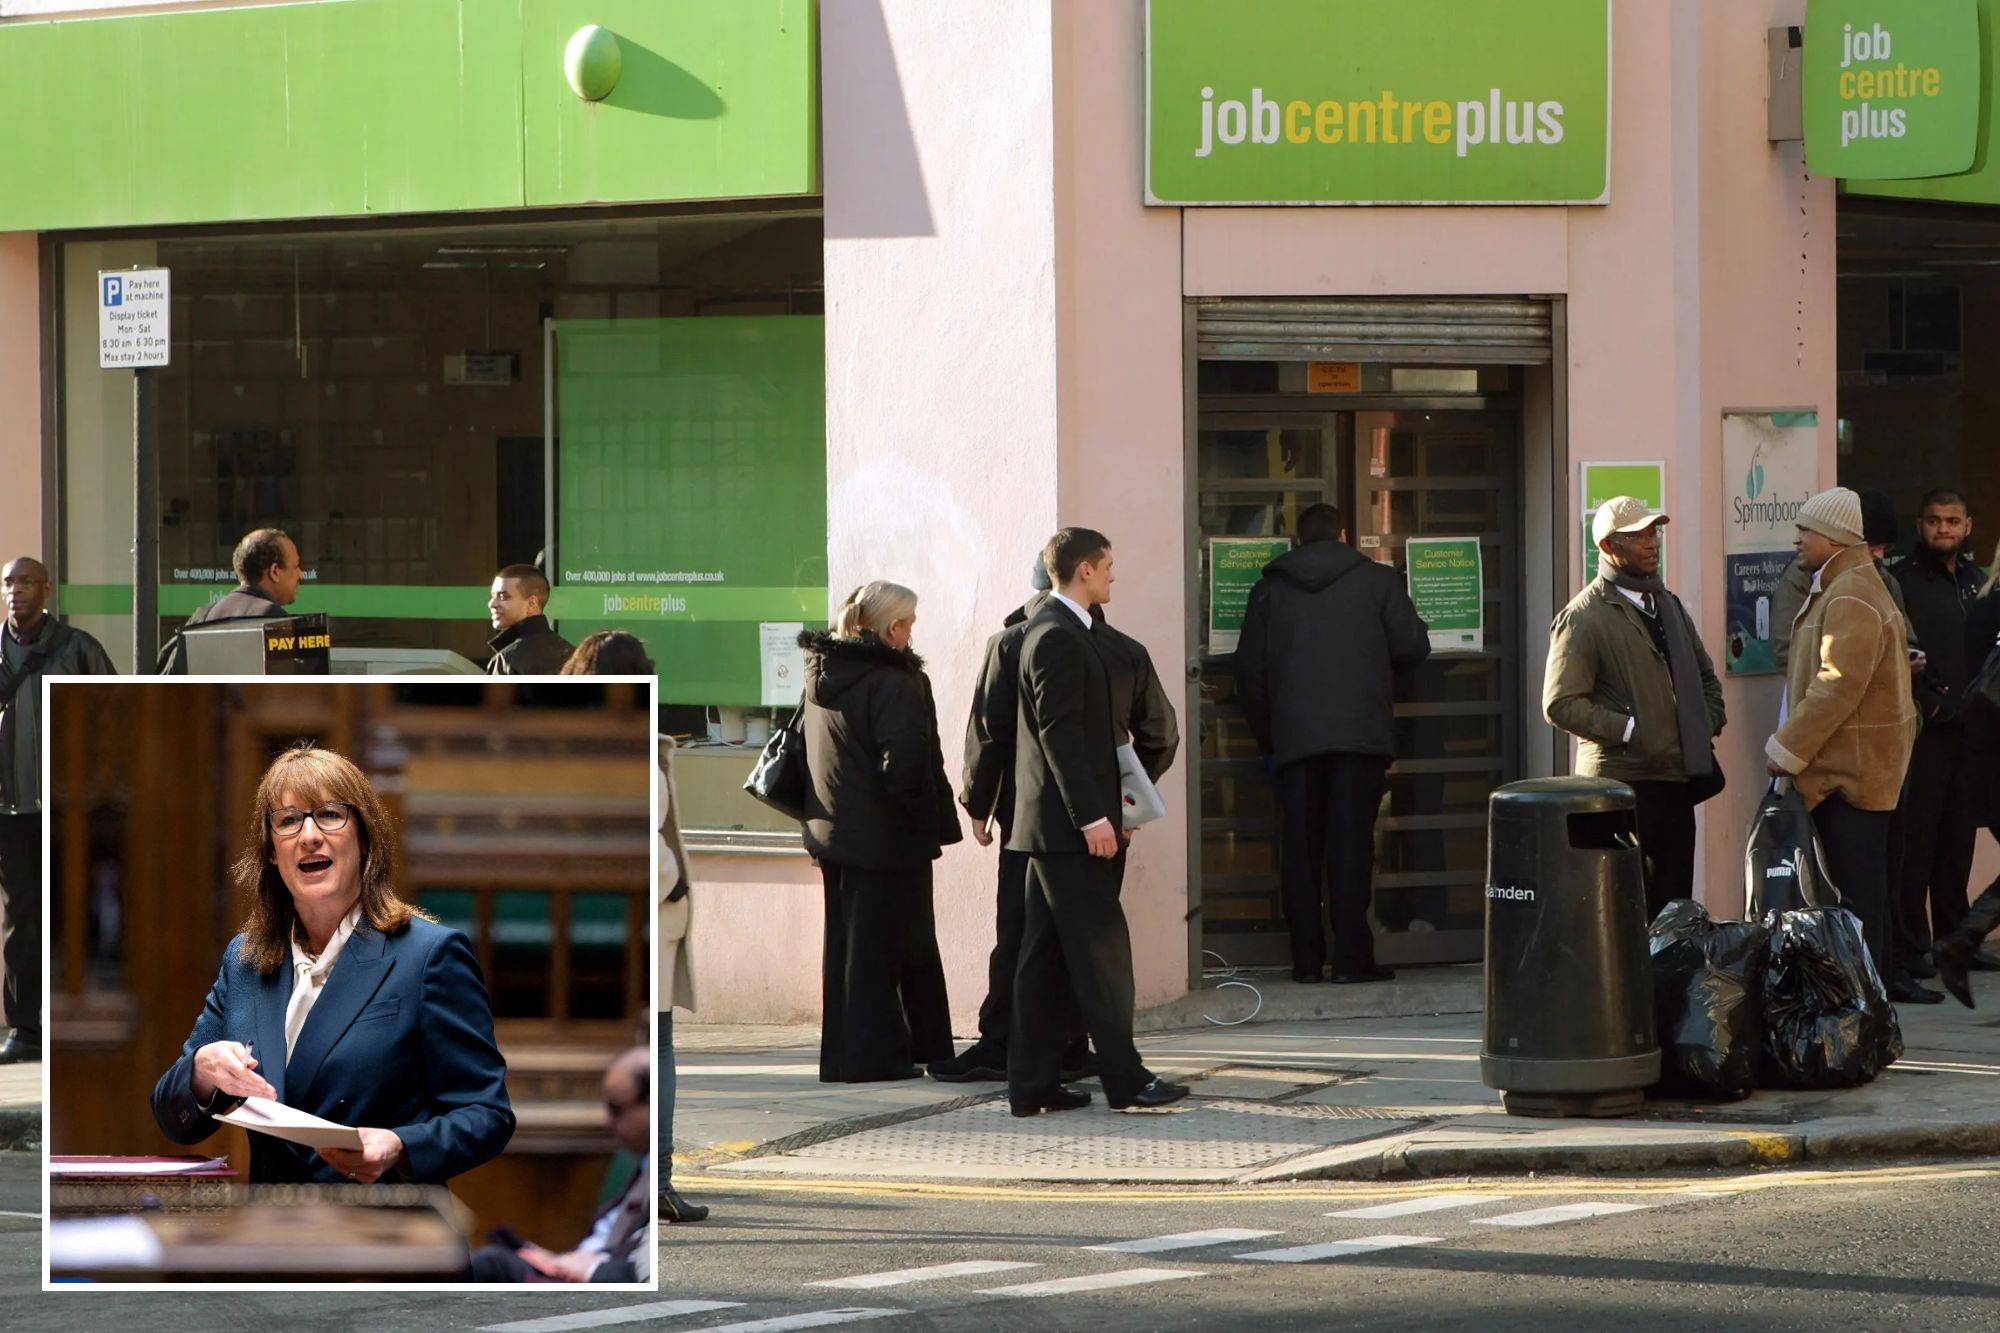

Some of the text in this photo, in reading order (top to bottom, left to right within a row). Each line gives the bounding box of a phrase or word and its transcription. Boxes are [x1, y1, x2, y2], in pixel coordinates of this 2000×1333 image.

[1840, 23, 1891, 68] job
[1840, 63, 1941, 100] centre
[1195, 86, 1564, 157] jobcentreplus
[1841, 102, 1906, 147] plus
[129, 280, 160, 290] Pay here
[108, 280, 120, 304] P
[125, 291, 164, 301] at machine
[109, 310, 158, 321] Display ticket
[138, 324, 151, 333] Sat
[155, 339, 166, 347] pm
[104, 351, 164, 362] Max stay 2 hours
[1424, 550, 1464, 559] Customer
[1220, 560, 1253, 569] Service
[1416, 559, 1475, 569] Service Notice
[1734, 563, 1760, 576] Careers
[174, 568, 188, 579] Over
[215, 568, 228, 581] jobs
[565, 570, 581, 581] Over
[611, 570, 626, 583] jobs
[628, 571, 635, 581] at
[603, 593, 687, 615] jobcentreplus
[268, 635, 331, 651] PAY HERE
